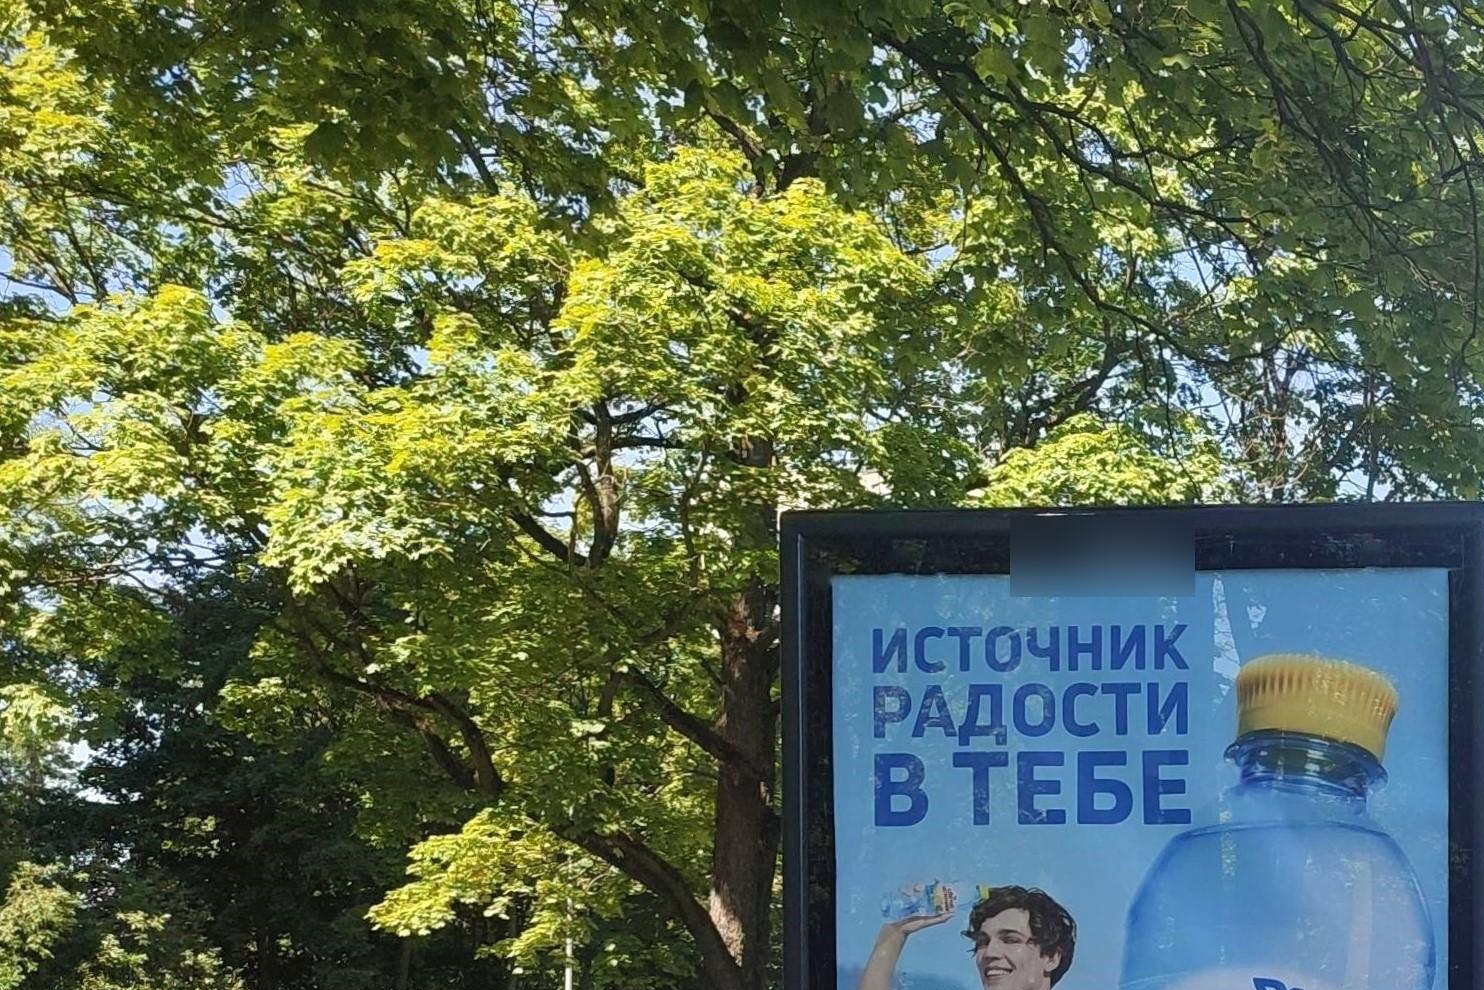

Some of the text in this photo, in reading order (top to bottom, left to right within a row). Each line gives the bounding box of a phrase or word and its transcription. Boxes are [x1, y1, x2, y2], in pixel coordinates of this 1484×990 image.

[872, 624, 1190, 673] ИСТОЧНИК
[872, 682, 1190, 746] РАДОСТИ
[873, 749, 1192, 827] В ТЕБЕ
